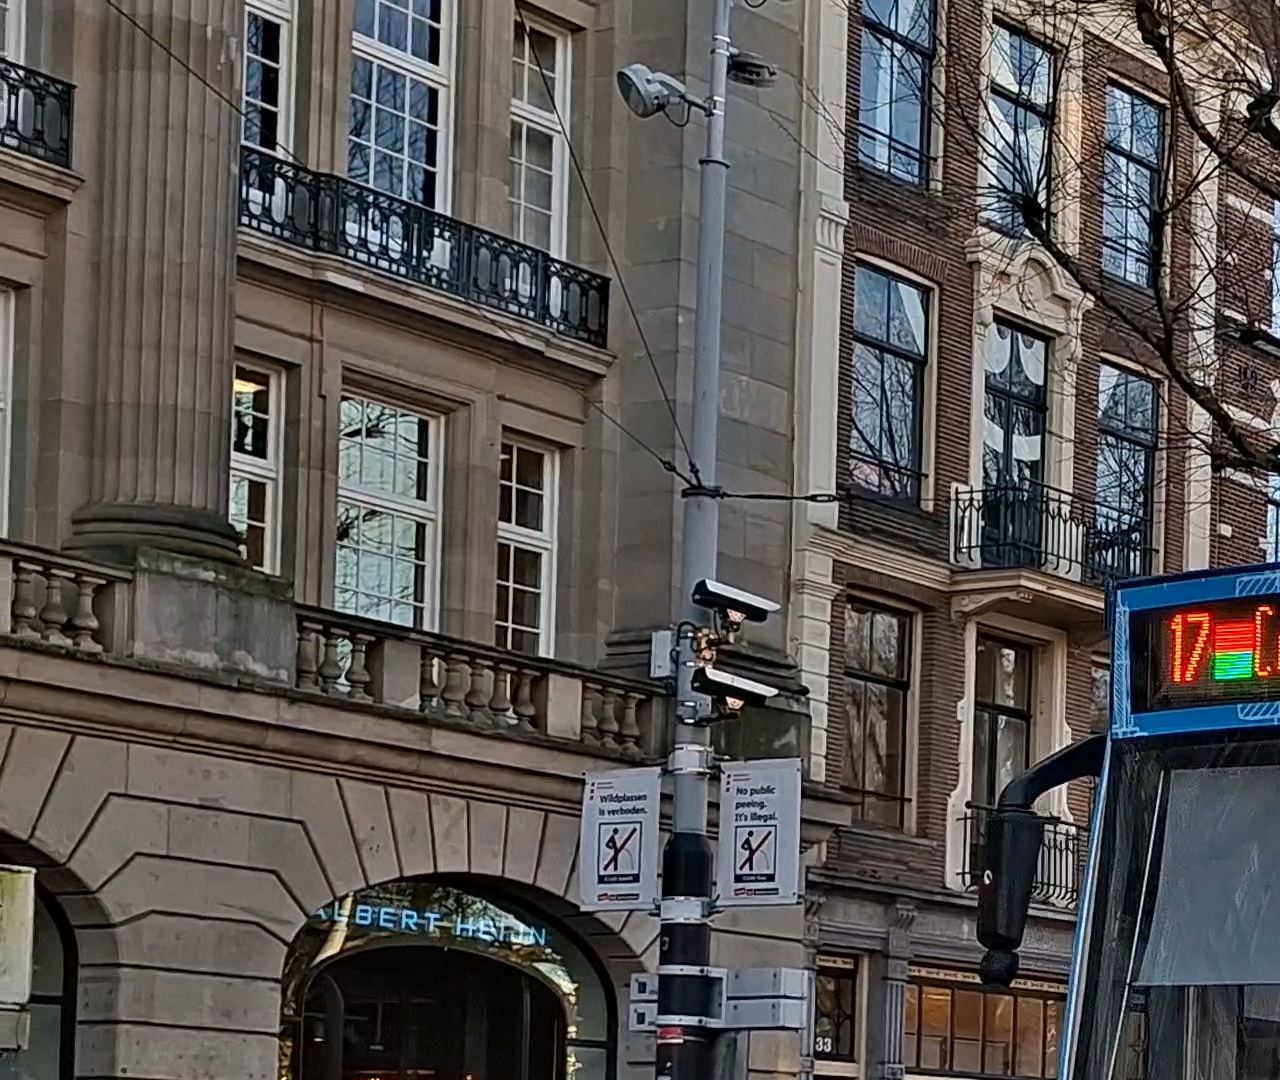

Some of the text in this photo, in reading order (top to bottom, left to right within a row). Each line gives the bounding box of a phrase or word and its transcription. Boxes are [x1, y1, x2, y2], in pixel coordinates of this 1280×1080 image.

[1170, 612, 1211, 682] 17
[736, 785, 776, 798] No public
[816, 1037, 832, 1052] 33
